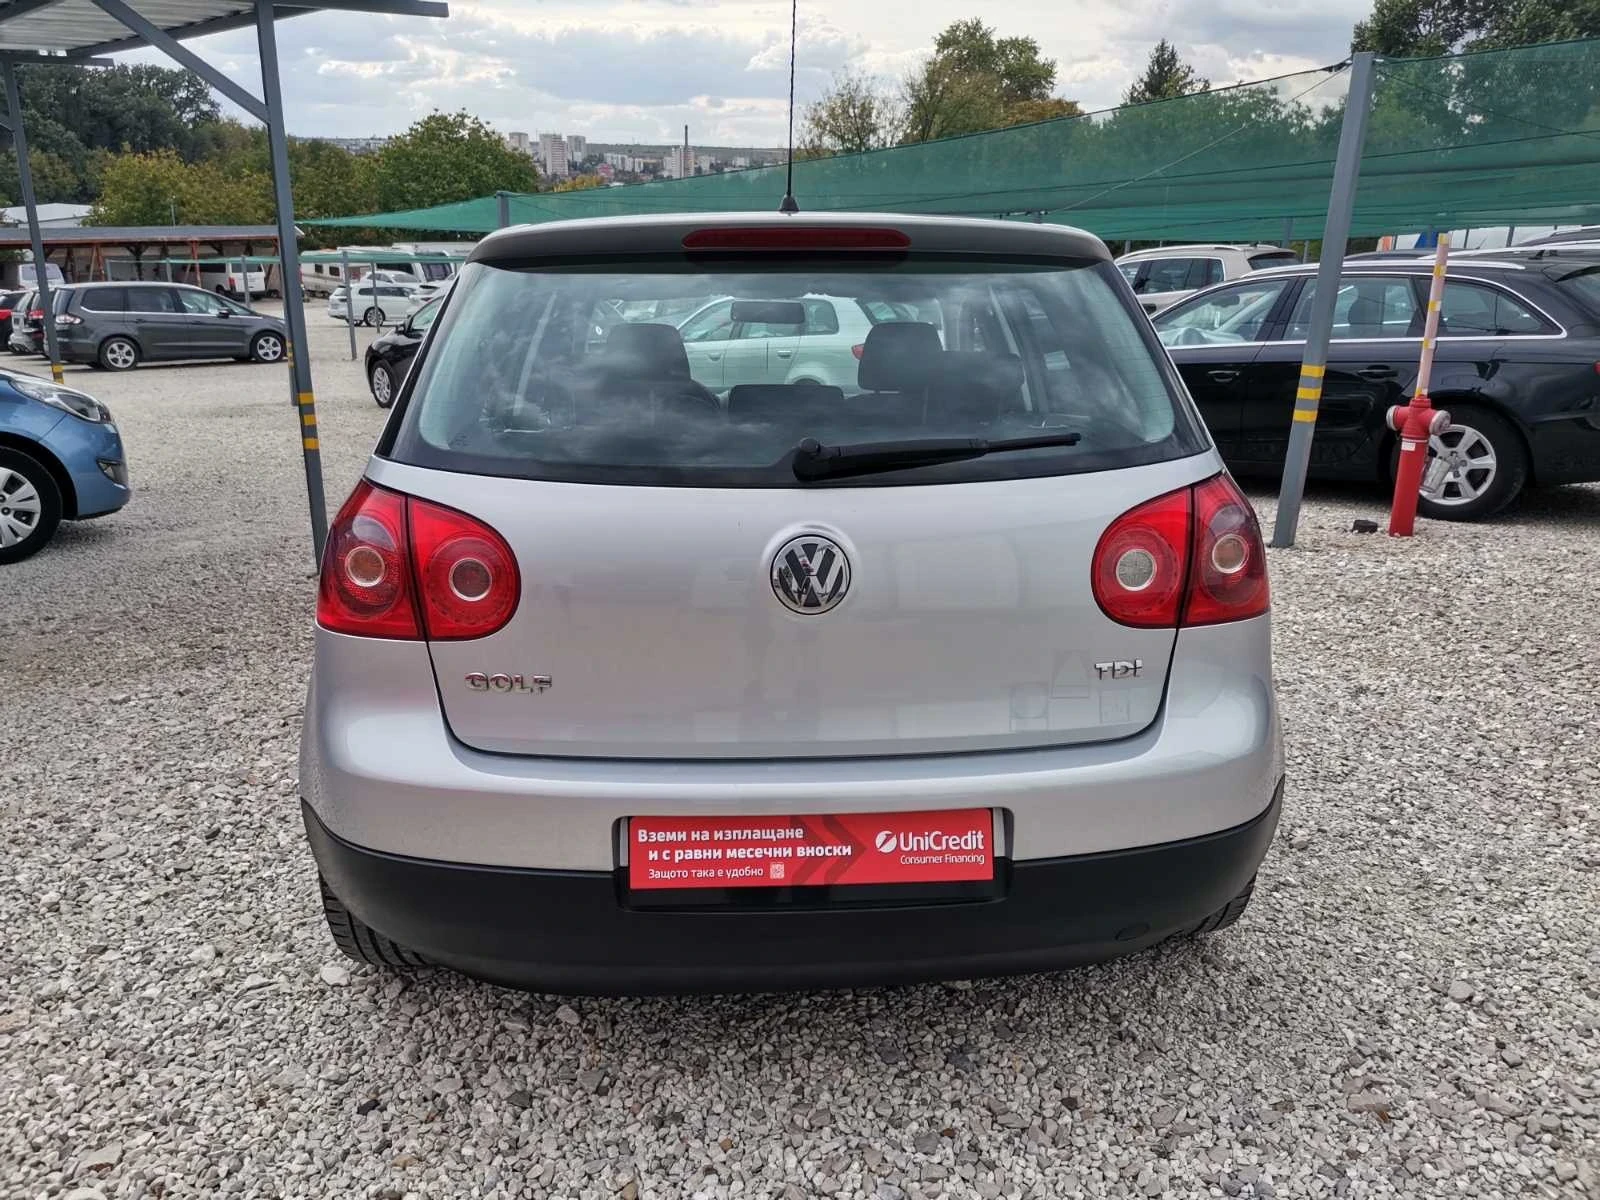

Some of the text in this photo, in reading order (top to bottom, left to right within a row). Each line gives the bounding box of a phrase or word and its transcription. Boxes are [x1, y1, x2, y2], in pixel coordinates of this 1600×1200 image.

[1094, 659, 1142, 680] TDI
[465, 672, 552, 695] GOLF
[638, 828, 804, 842] Вземи на изплащане
[900, 830, 984, 851] UniCredit
[648, 849, 659, 861] и
[674, 848, 723, 863] равни
[726, 846, 792, 859] месечни
[796, 845, 852, 857] вноски
[900, 853, 985, 865] Consumer Financing
[648, 868, 689, 879] Защото
[691, 869, 715, 878] така
[726, 866, 764, 878] удобно
